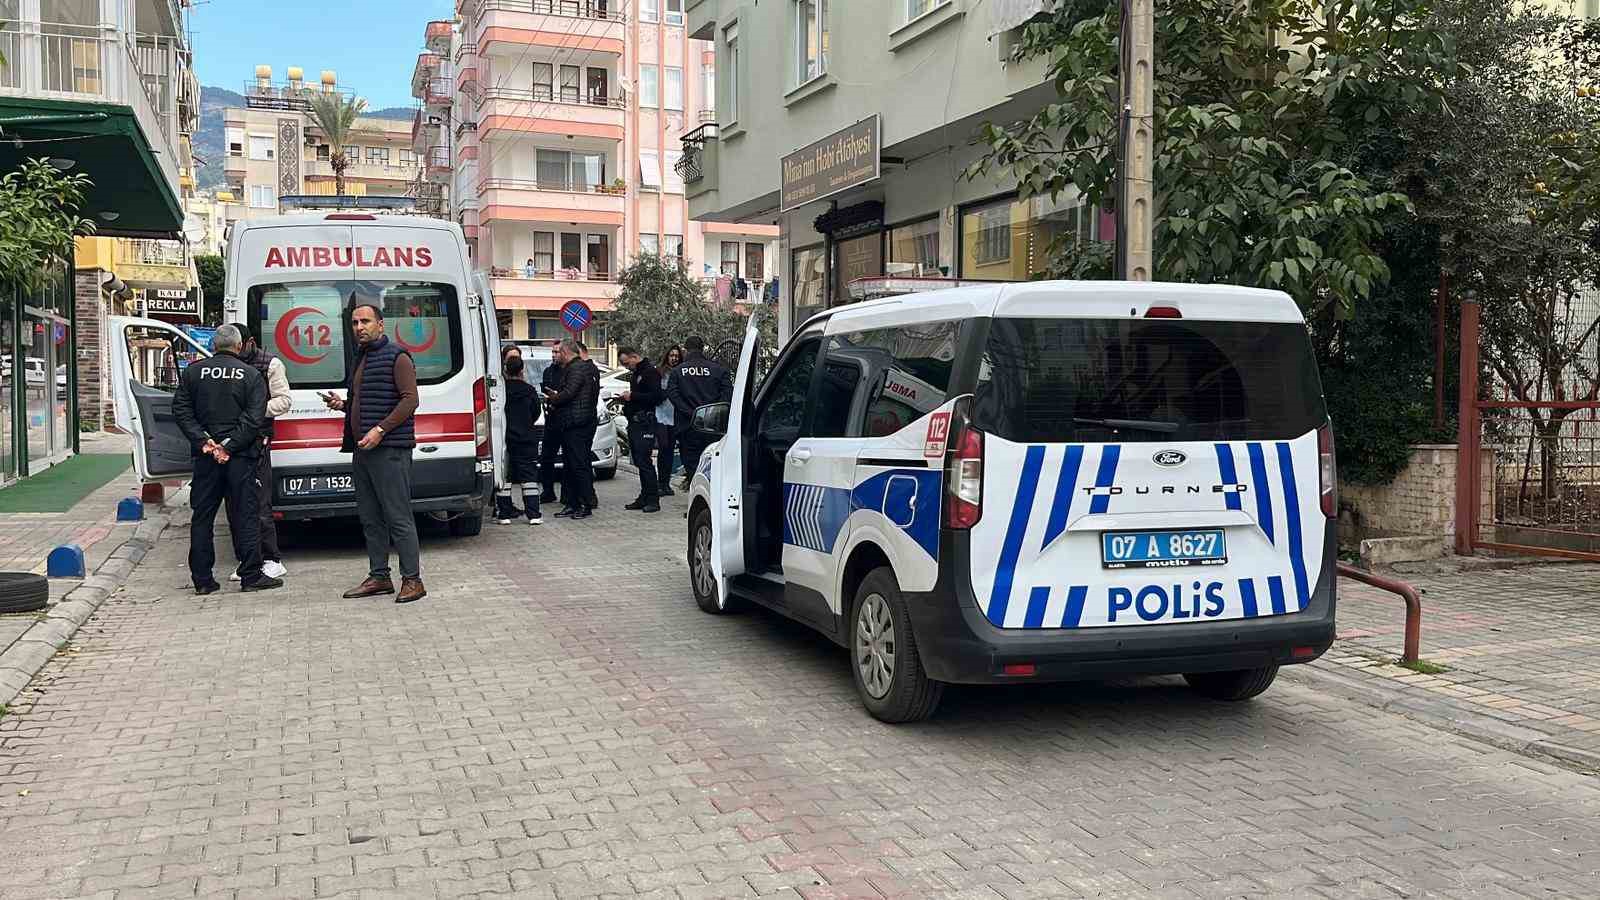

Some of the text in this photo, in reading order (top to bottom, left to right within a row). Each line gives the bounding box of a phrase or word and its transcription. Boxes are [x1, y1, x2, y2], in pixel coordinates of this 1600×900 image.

[264, 247, 433, 268] AMBULANS
[148, 299, 196, 311] REKLAM
[289, 325, 331, 346] 112
[930, 418, 946, 439] 112
[289, 476, 352, 491] 07 F 1532
[1083, 484, 1248, 496] TOURNEO
[1112, 533, 1217, 559] 07 A 8627
[1145, 559, 1189, 568] mutlu
